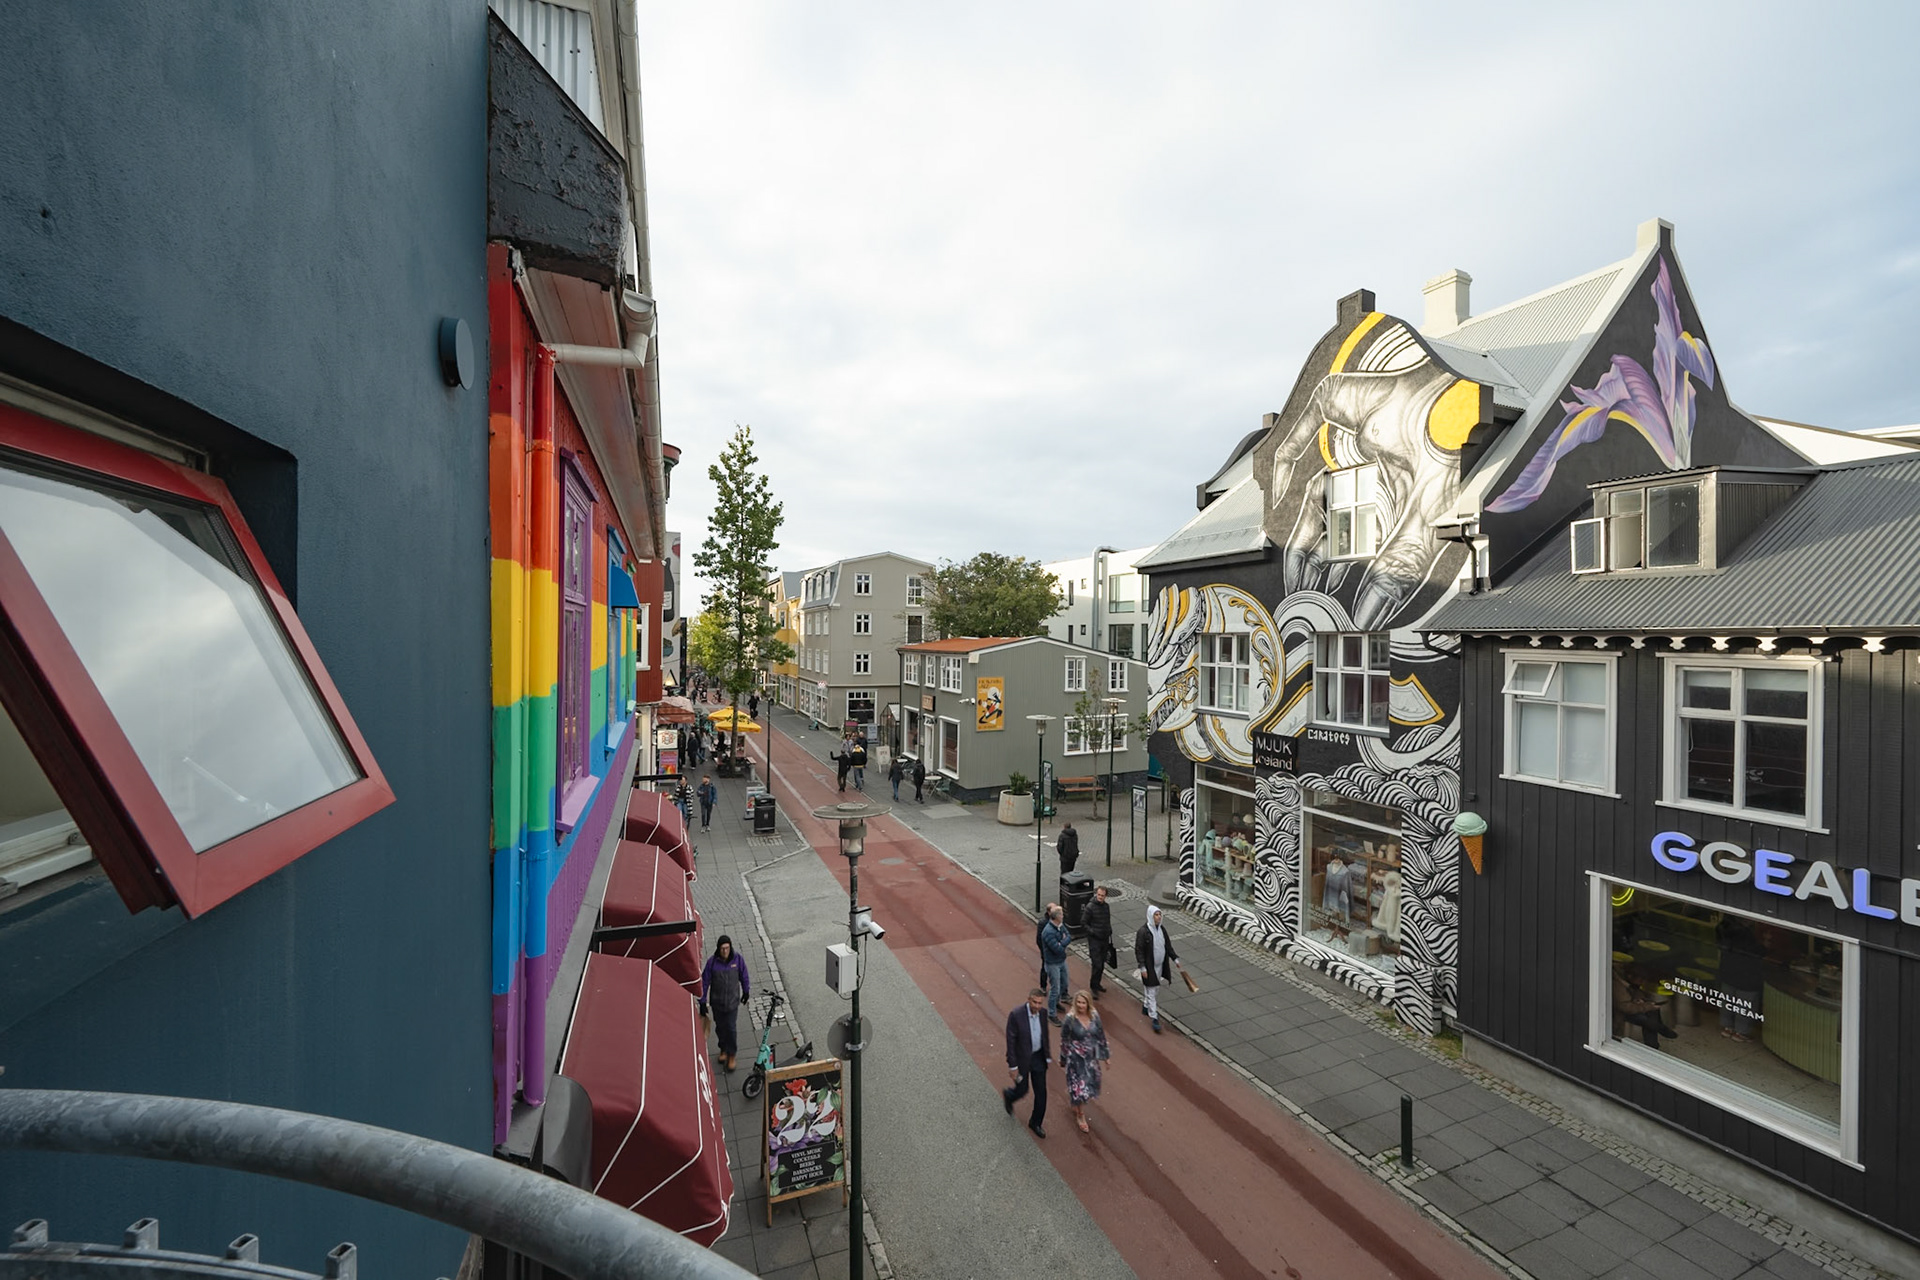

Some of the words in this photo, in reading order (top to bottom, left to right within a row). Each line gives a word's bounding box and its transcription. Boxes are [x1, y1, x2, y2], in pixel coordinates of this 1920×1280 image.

[1255, 753, 1293, 771] Iceland
[1675, 977, 1707, 994] FRESH
[1709, 989, 1752, 1009] ITALIAN
[1663, 982, 1703, 1001] GELATO
[1705, 996, 1723, 1008] ICE
[1725, 1003, 1765, 1023] CREAM
[775, 1090, 836, 1146] 22
[807, 1147, 823, 1155] MUSIC
[793, 1153, 821, 1164] COCKTAILS
[799, 1160, 816, 1169] BEERS
[791, 1174, 808, 1182] HAPPY
[809, 1170, 824, 1179] HOUR
[792, 1164, 823, 1176] BARSNACKS
